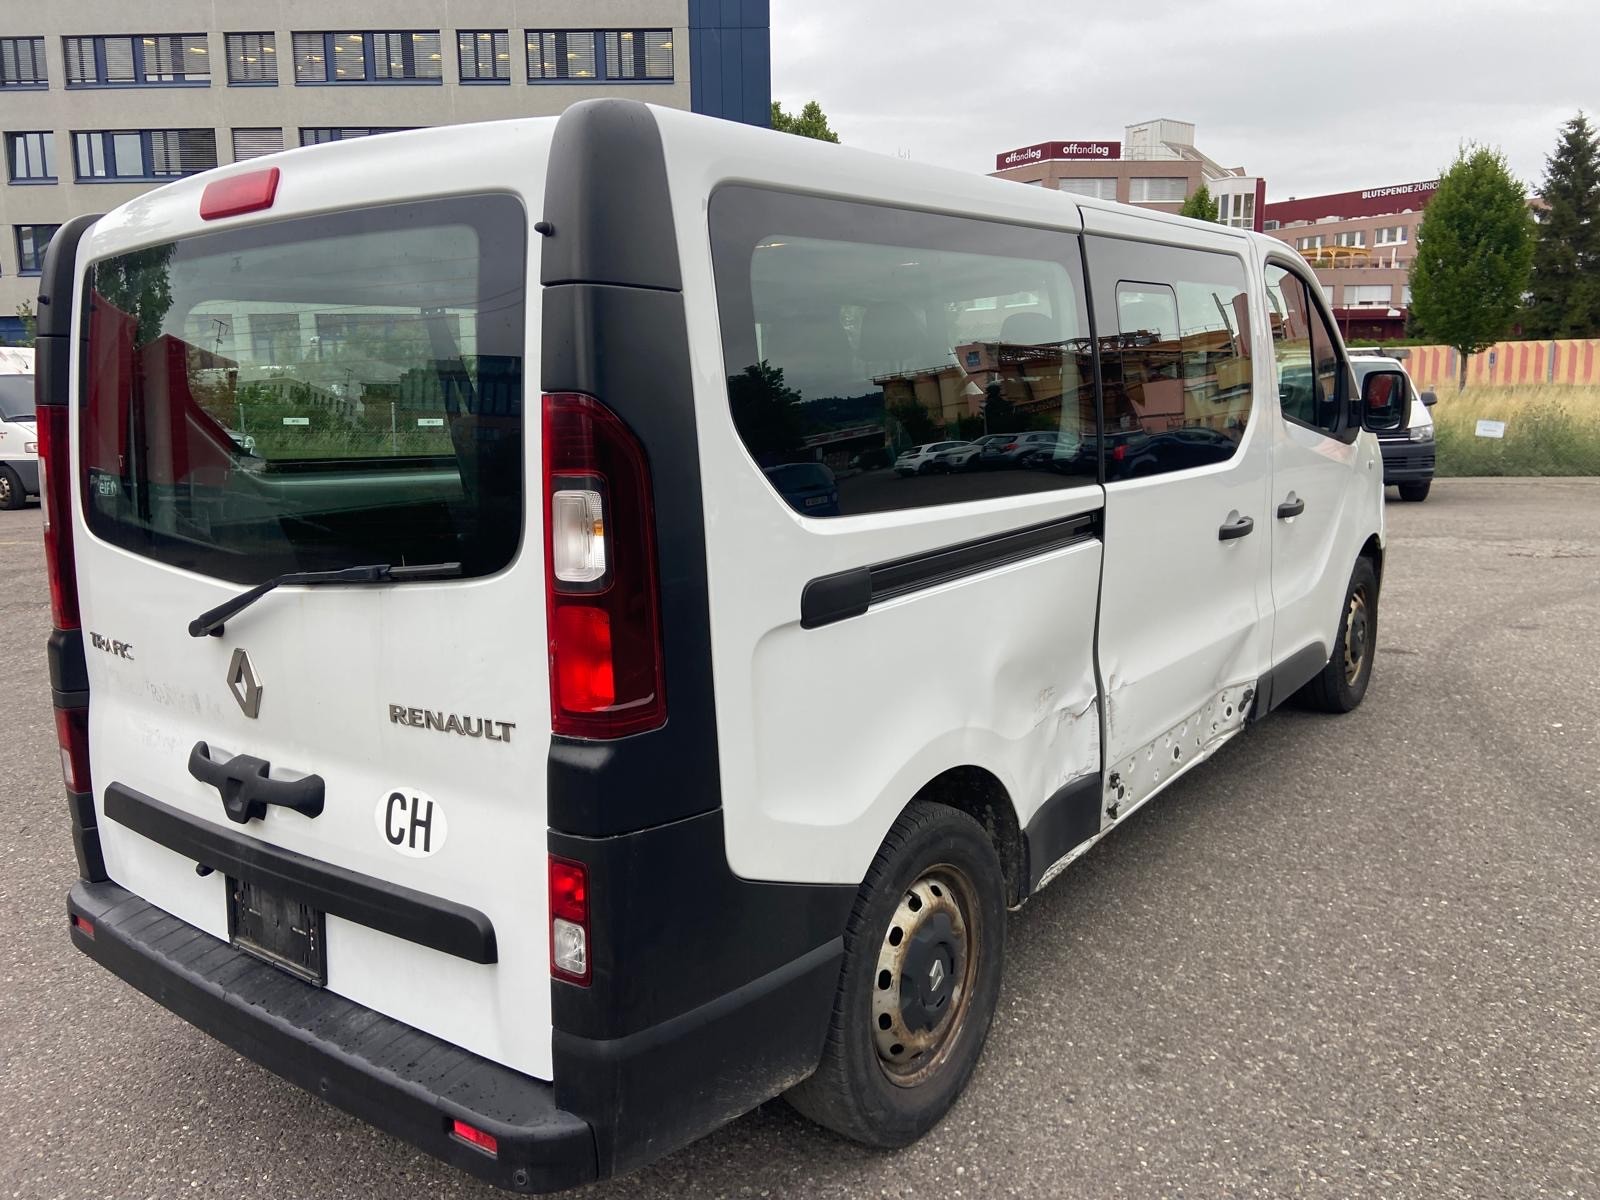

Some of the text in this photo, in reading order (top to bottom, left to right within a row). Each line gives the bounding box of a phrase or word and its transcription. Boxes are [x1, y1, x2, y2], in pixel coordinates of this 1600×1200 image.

[1005, 148, 1042, 164] offandlog
[1063, 143, 1109, 156] offandlog
[1362, 185, 1413, 199] BLUTSPENDE
[90, 632, 134, 661] TRAFIC
[389, 704, 516, 743] RENAULT
[385, 792, 433, 853] CH
